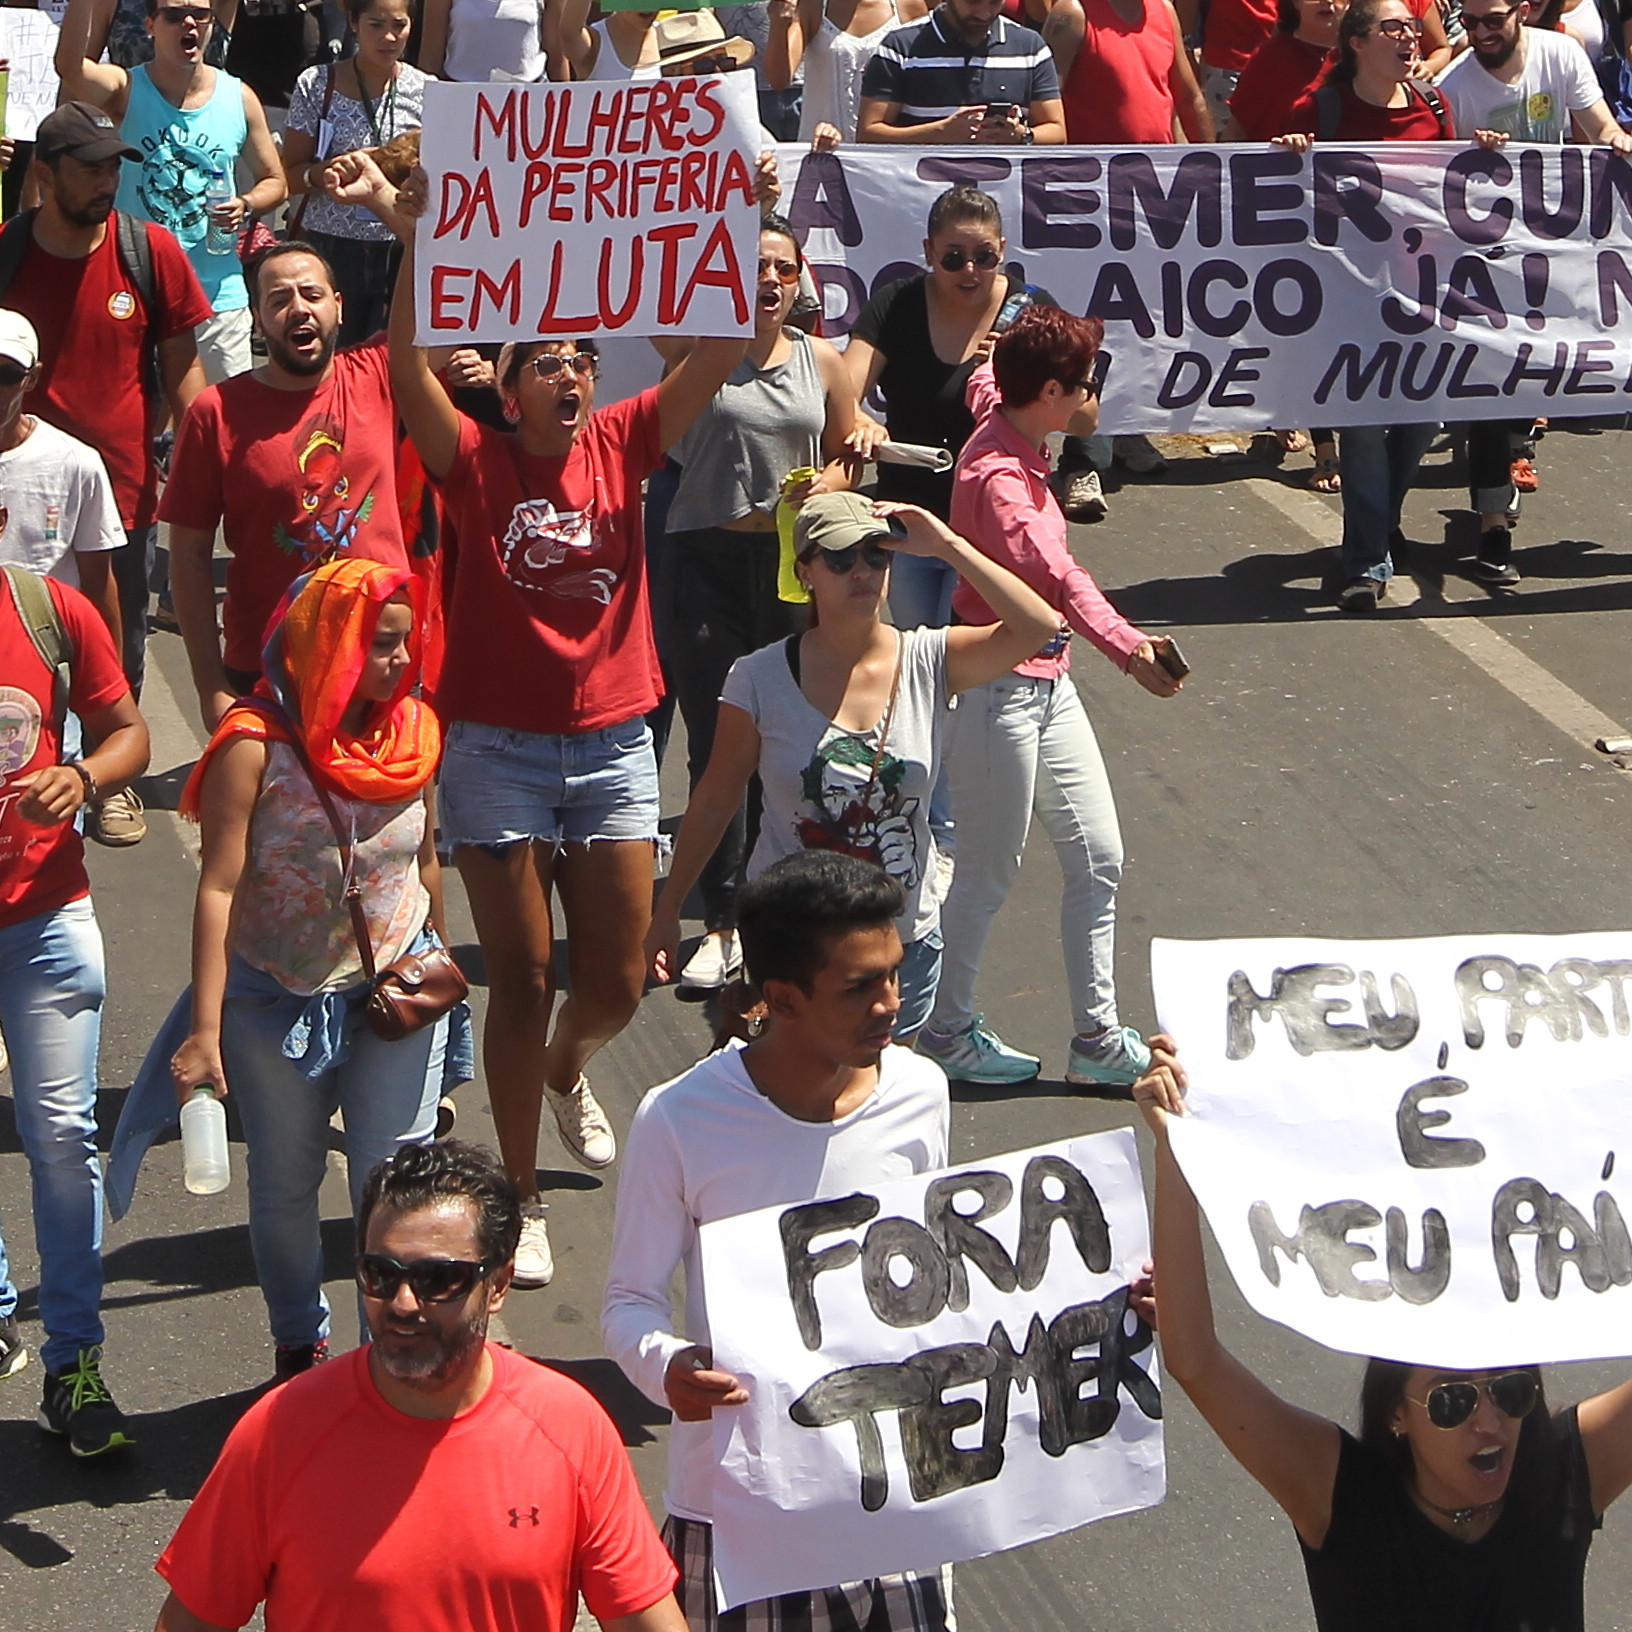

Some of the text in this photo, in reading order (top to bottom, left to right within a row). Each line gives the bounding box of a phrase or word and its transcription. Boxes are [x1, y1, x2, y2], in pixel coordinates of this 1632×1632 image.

[472, 77, 728, 164] MULHERES
[433, 166, 502, 242] DA
[518, 148, 758, 230] PERIFERIA
[429, 257, 522, 333] EM
[536, 216, 751, 335] LUTA
[1381, 244, 1550, 333] JÁ!
[1155, 344, 1269, 410] DE
[1224, 962, 1420, 1062] MEU
[1394, 1039, 1488, 1172] É
[777, 1153, 1114, 1353] FORA
[1246, 1196, 1454, 1307] MEU
[787, 1280, 1164, 1516] TEMER
